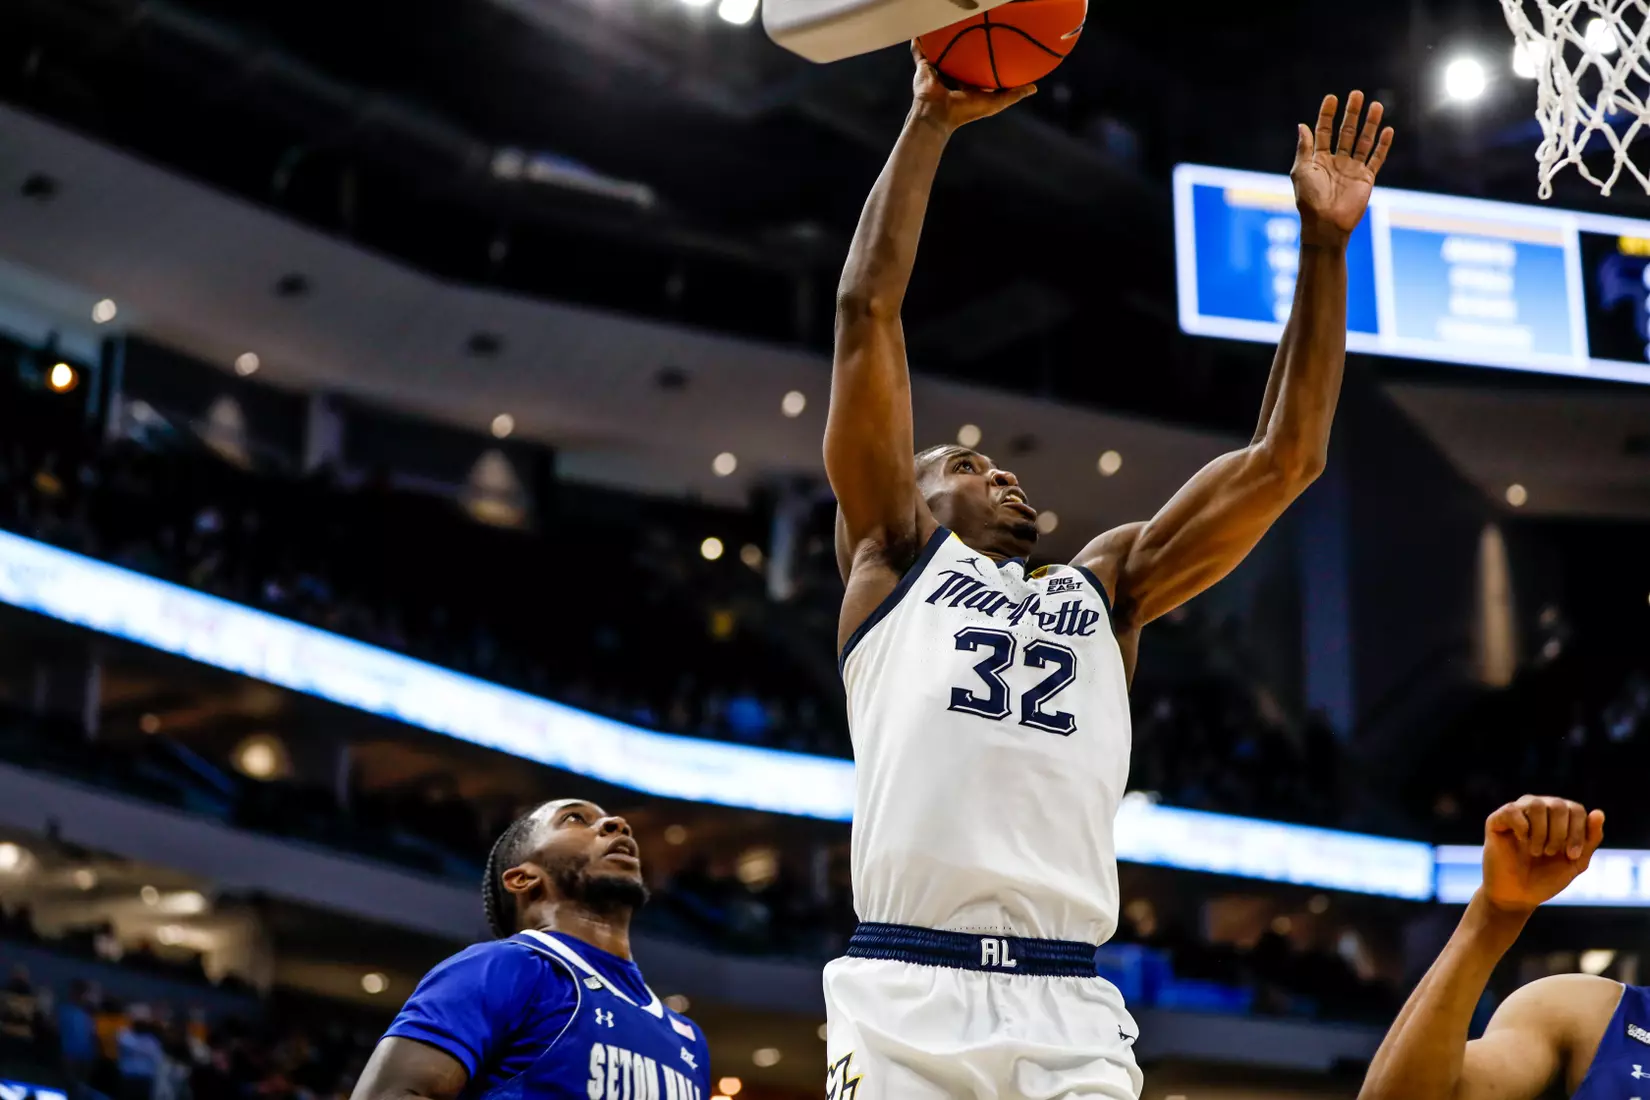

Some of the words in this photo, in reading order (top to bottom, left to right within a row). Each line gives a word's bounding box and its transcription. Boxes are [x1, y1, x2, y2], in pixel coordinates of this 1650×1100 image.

[1047, 582, 1083, 592] EAST
[1049, 577, 1073, 586] BIG
[925, 570, 1099, 636] Marette
[947, 626, 1077, 736] 32
[980, 938, 1017, 968] AL
